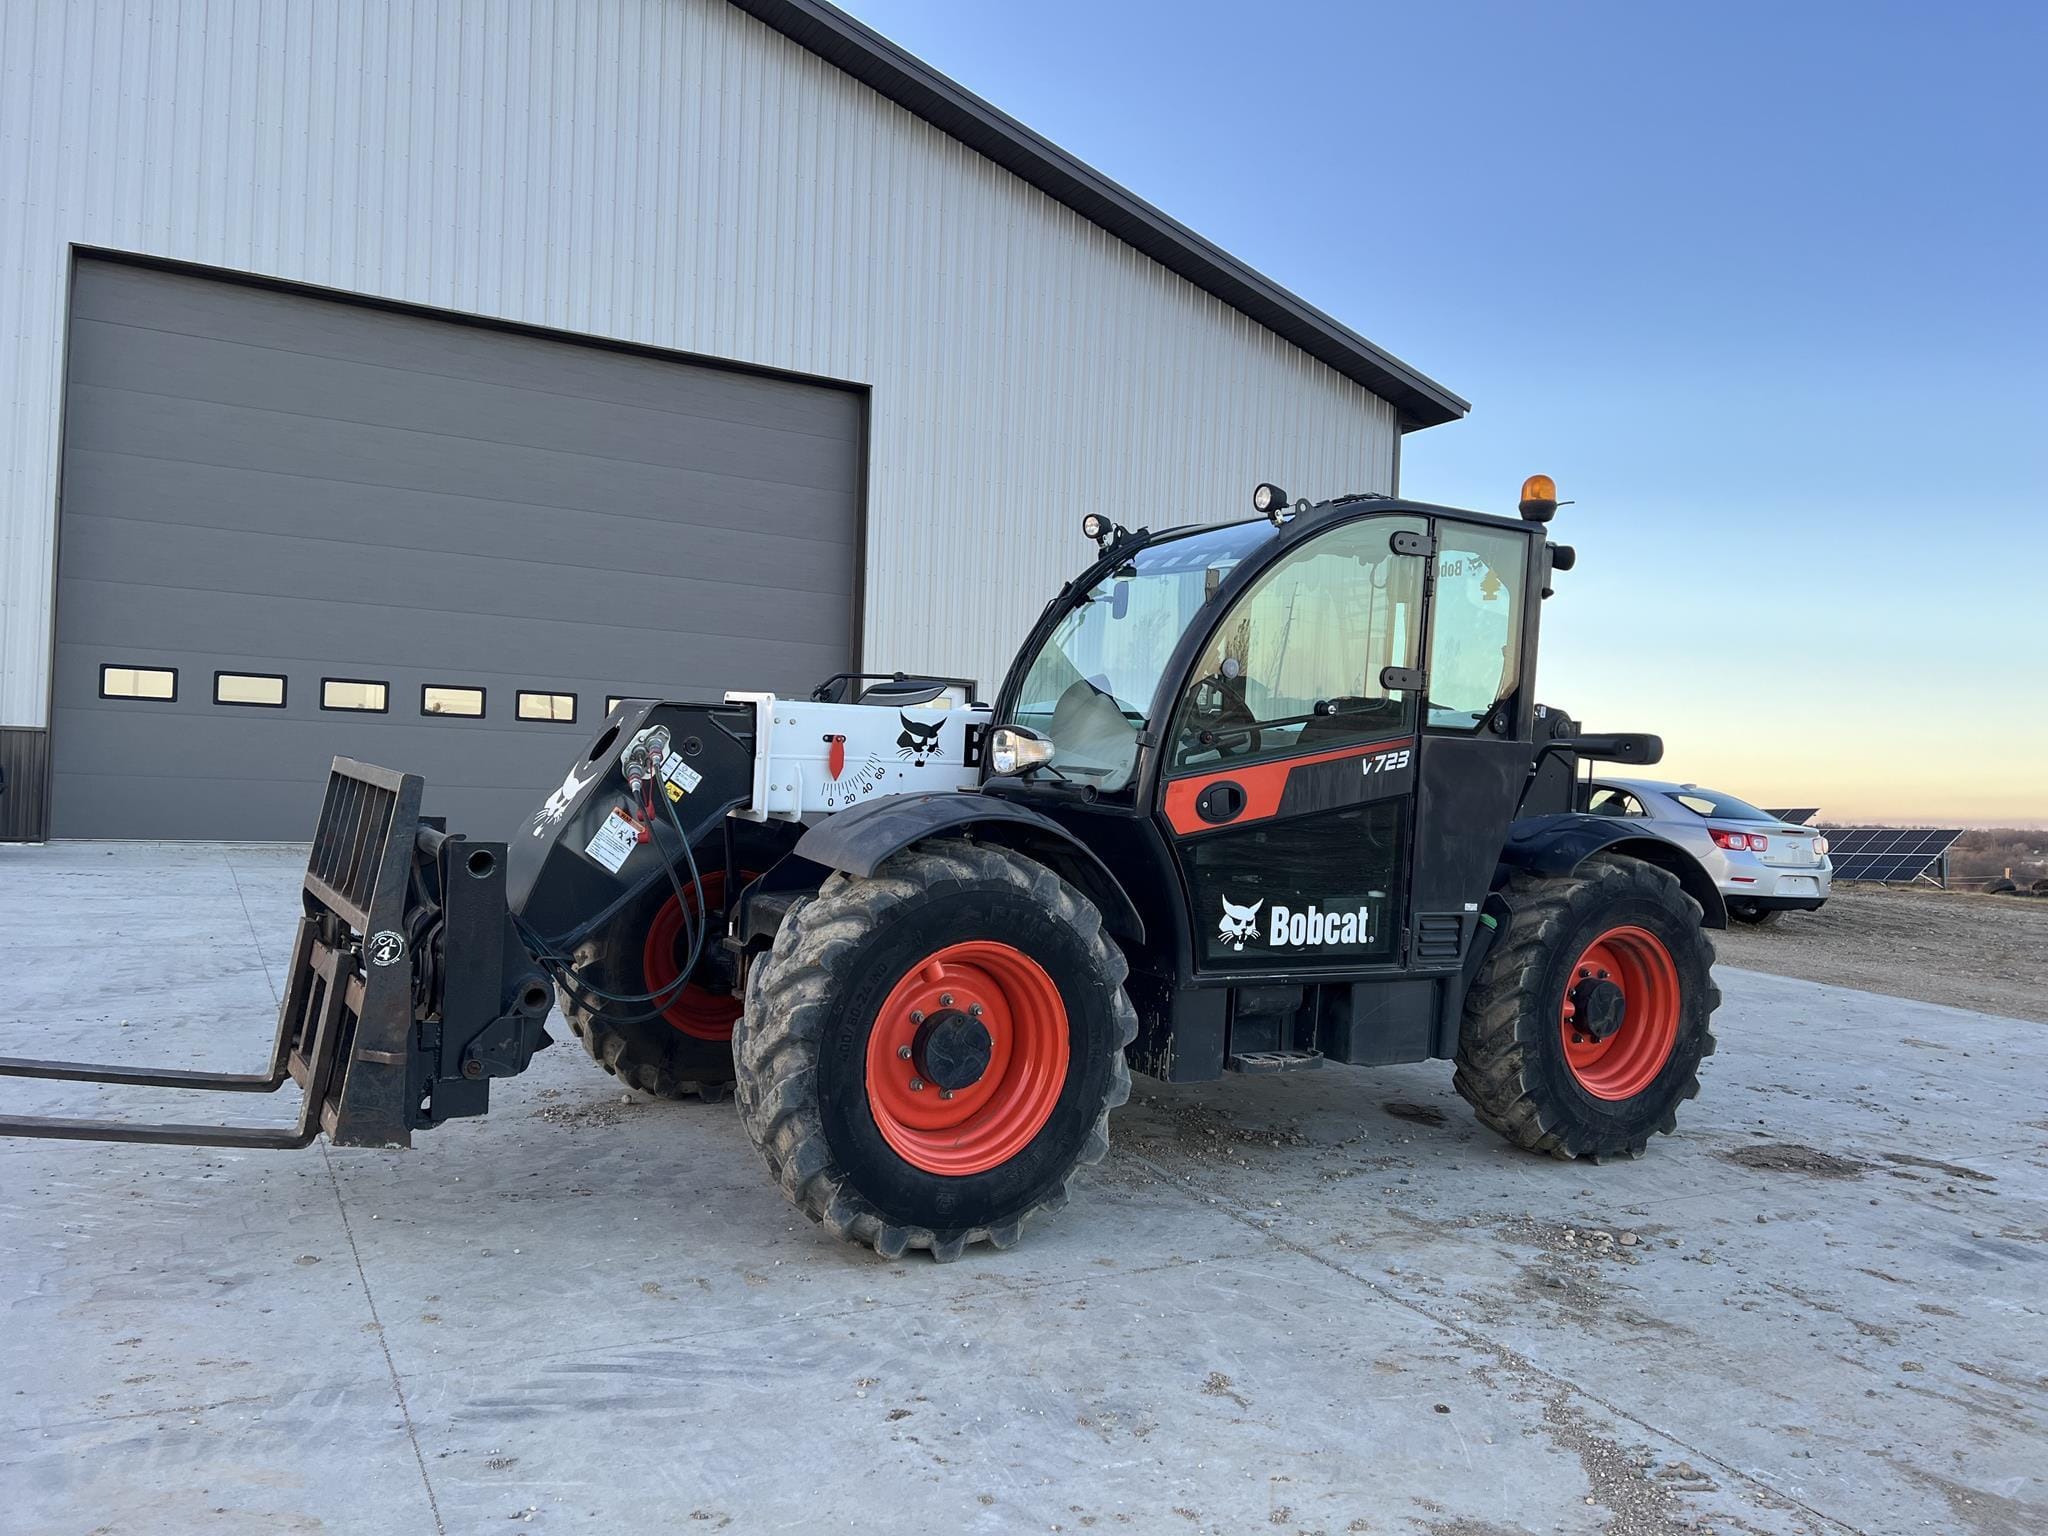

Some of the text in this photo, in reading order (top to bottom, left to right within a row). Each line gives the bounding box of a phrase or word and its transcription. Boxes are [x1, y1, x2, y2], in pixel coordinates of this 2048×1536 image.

[1362, 750, 1410, 776] V723
[827, 767, 886, 807] 0 20 40 60
[1269, 905, 1369, 946] Bobcat
